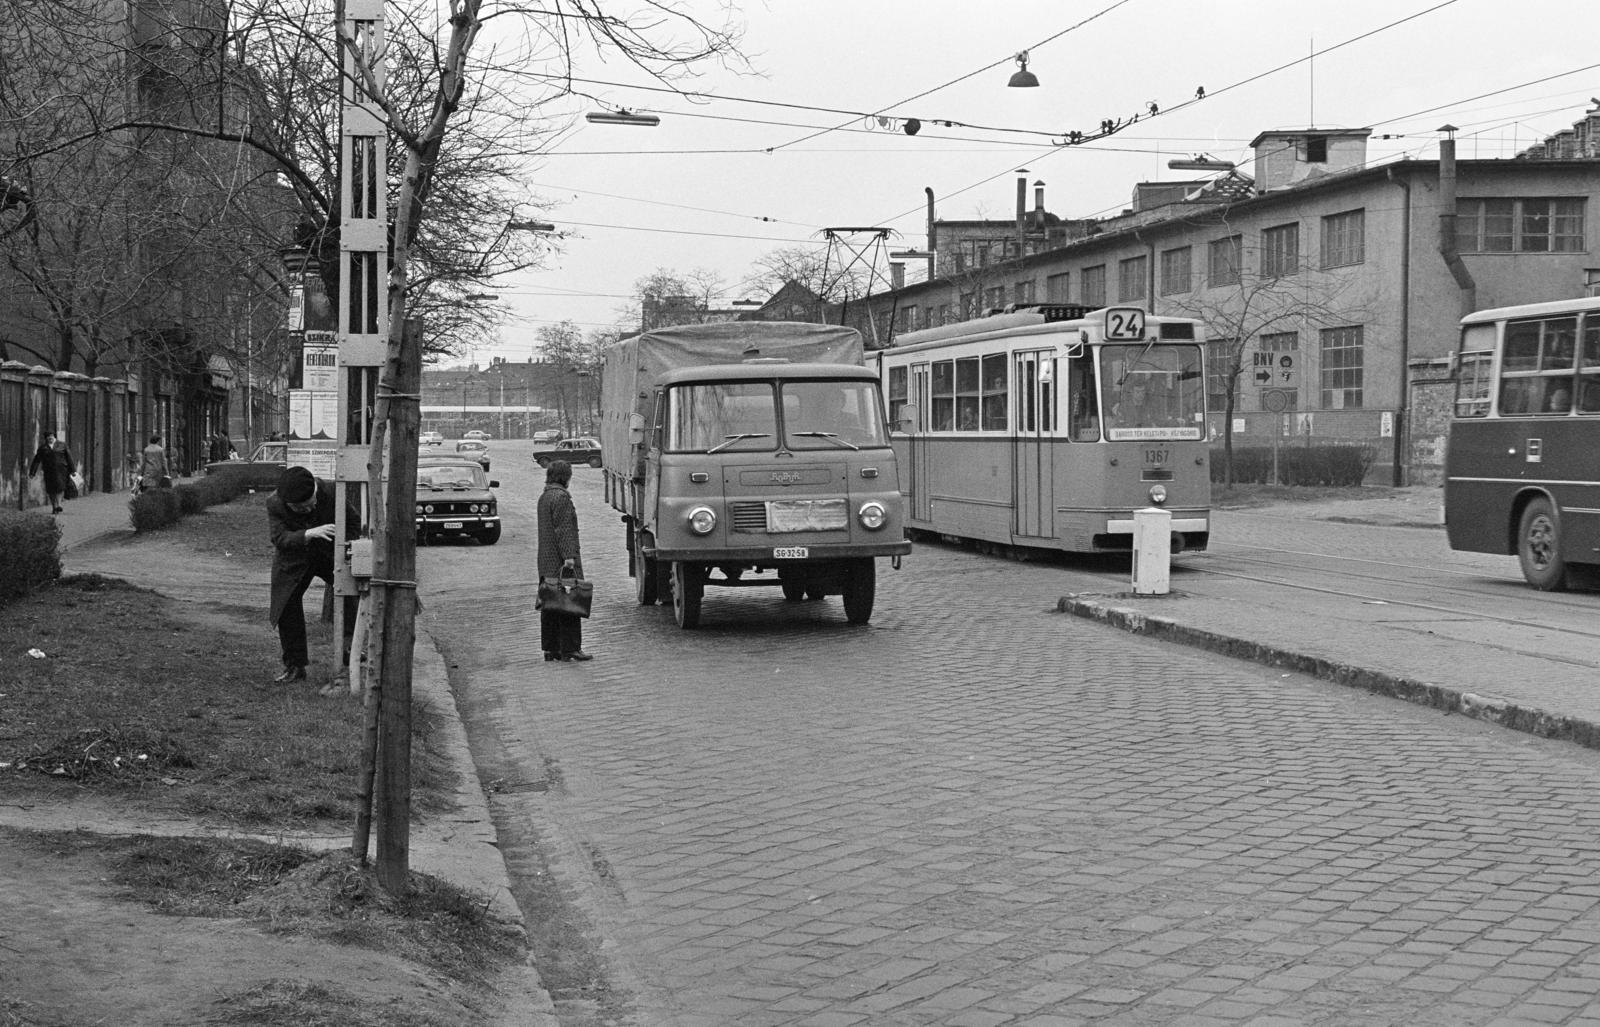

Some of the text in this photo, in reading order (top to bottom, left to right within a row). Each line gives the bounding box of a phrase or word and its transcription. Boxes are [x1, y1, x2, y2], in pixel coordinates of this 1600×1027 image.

[1111, 313, 1138, 337] 24
[1253, 352, 1274, 366] BNV
[1145, 450, 1170, 463] 1367
